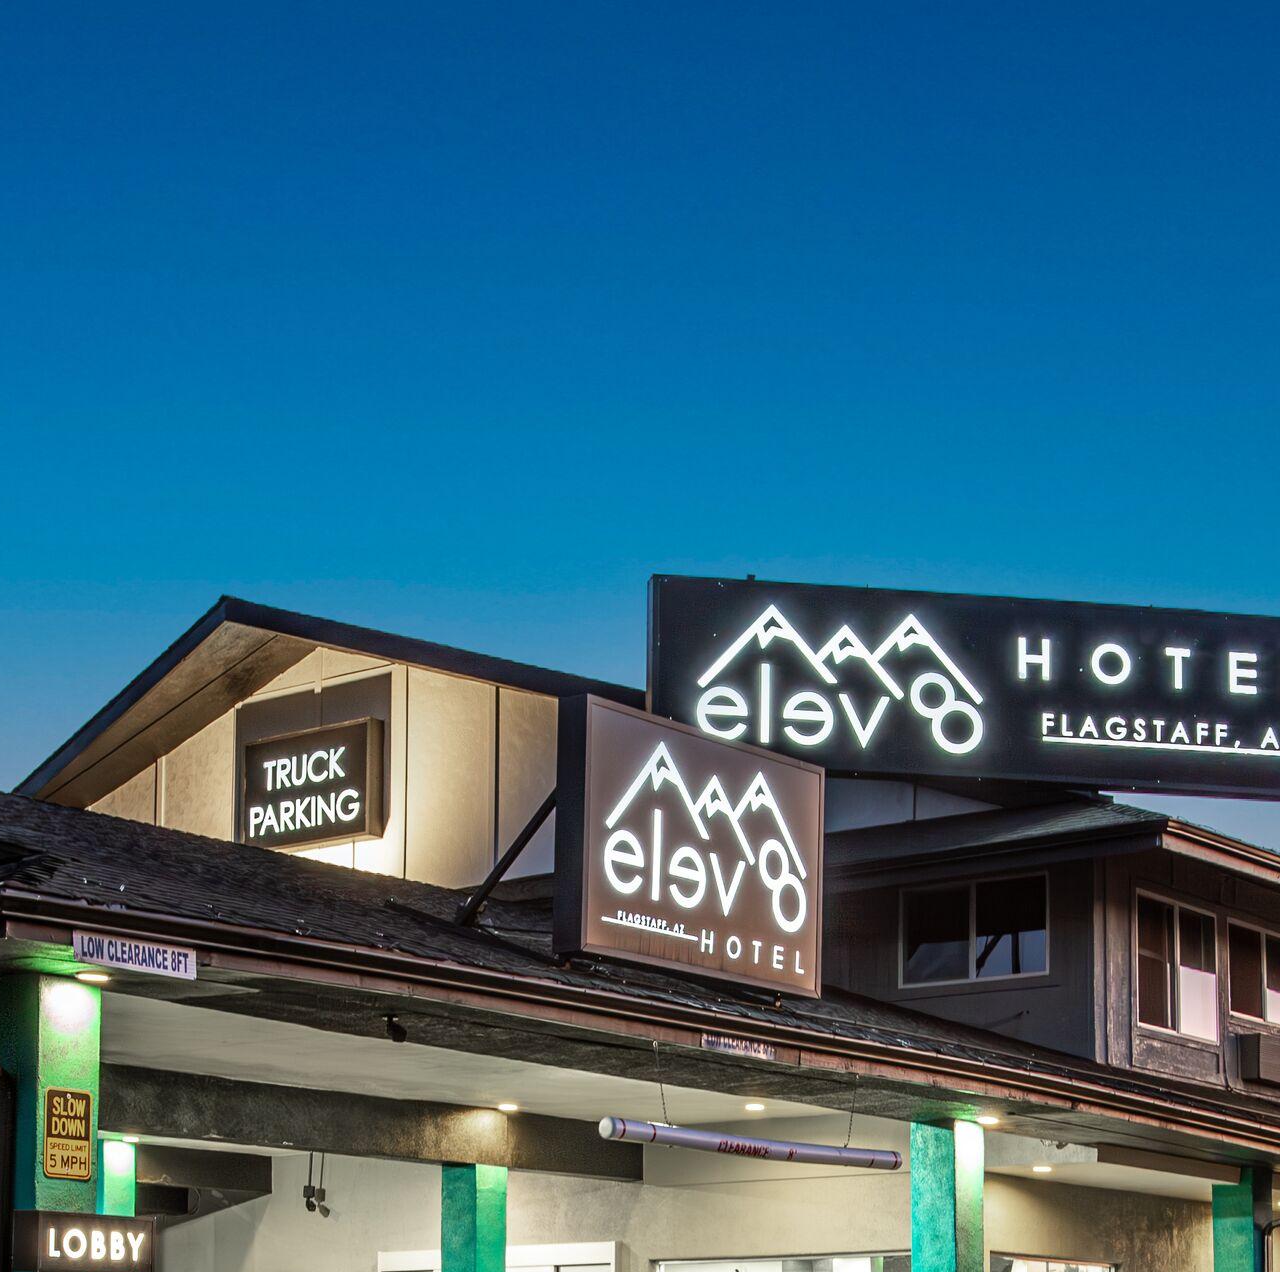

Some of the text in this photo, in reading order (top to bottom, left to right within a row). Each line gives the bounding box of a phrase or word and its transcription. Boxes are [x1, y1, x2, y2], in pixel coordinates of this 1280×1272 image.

[1041, 712, 1241, 749] FLAGSTAFF,
[262, 746, 346, 792] TRUCK
[248, 788, 361, 839] PARKING
[617, 910, 685, 935] FLAGSTAFF, AZ
[80, 935, 189, 974] LOW CLEARANCE 8FT
[701, 929, 805, 975] HOTEL
[52, 1096, 86, 1117] SLOW
[51, 1116, 86, 1138] DOWN
[49, 1142, 88, 1153] SPEED LIMIT
[49, 1153, 87, 1171] 5 MPH
[718, 1139, 769, 1159] CLEARANCE
[48, 1227, 145, 1262] LOBBY
